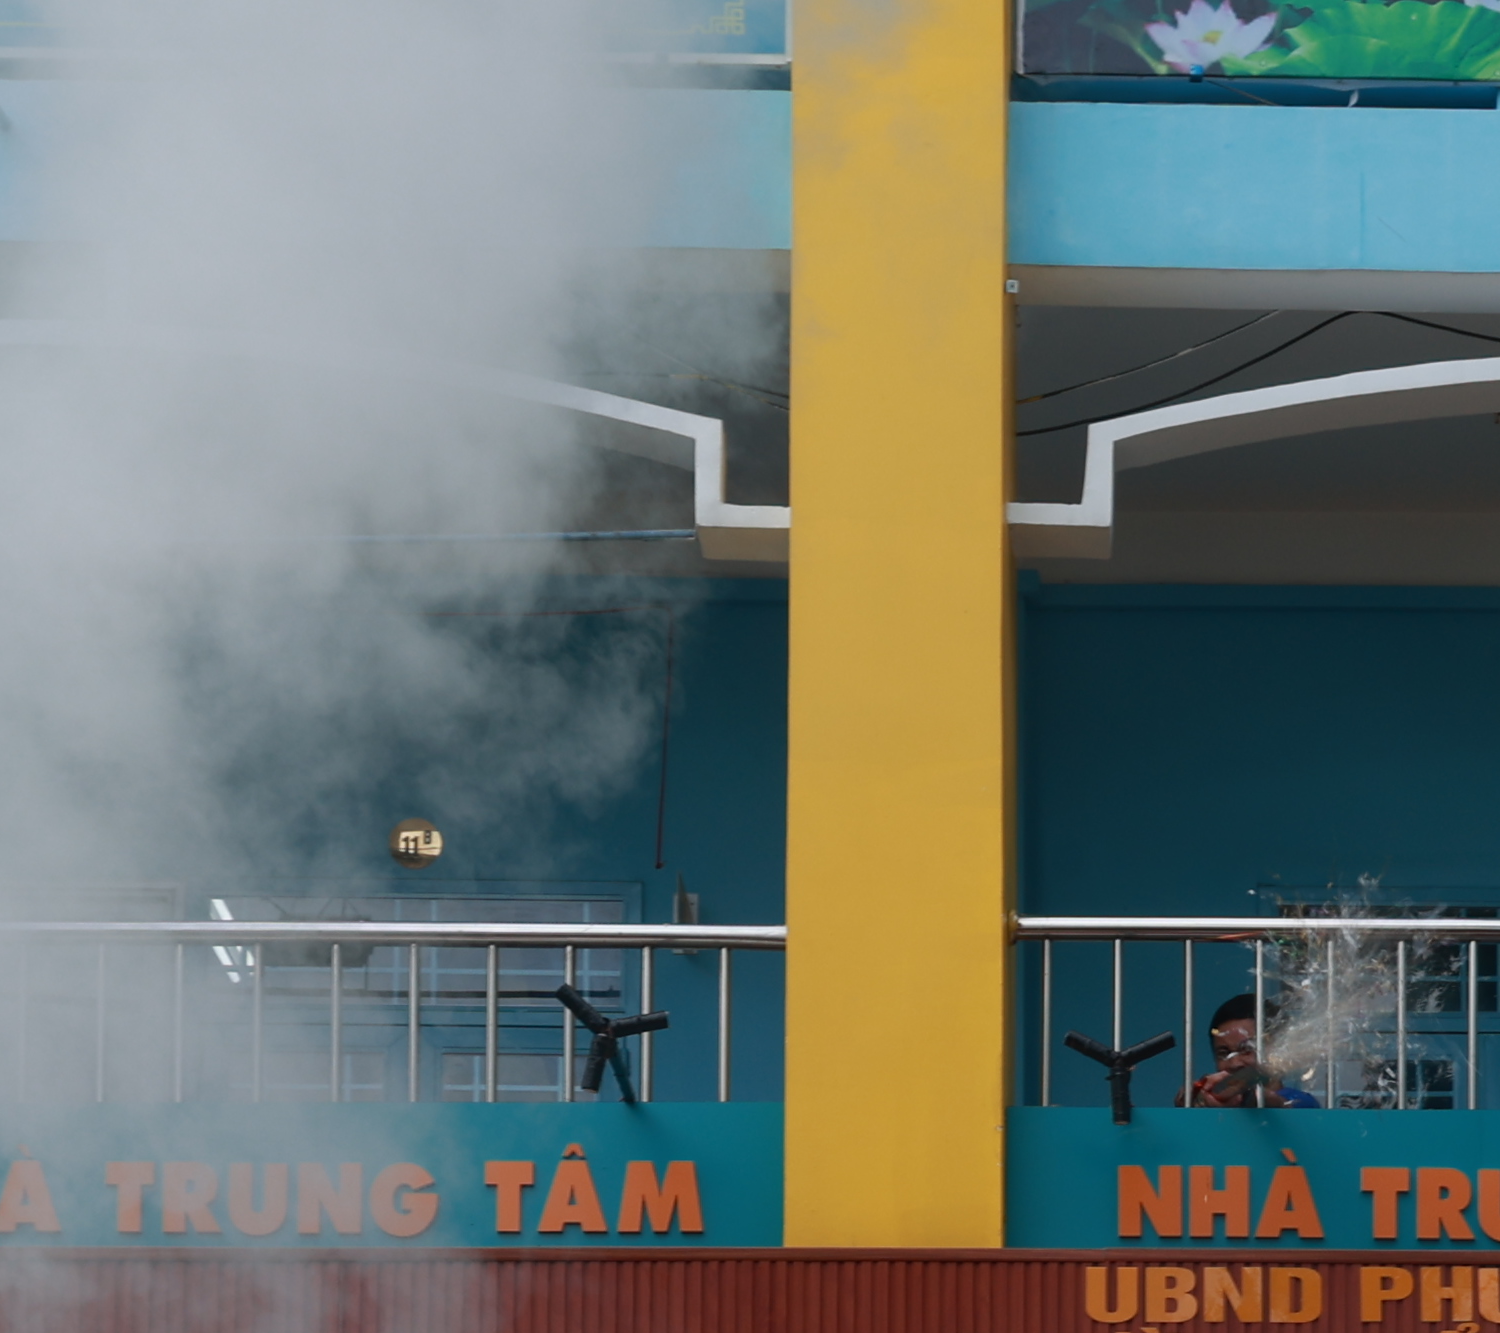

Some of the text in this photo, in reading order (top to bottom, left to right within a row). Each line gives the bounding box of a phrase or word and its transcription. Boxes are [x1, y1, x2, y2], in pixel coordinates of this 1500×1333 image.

[105, 1160, 439, 1237] TRUNG
[484, 1142, 704, 1235] TÂM
[1084, 1265, 1323, 1325] UBND
